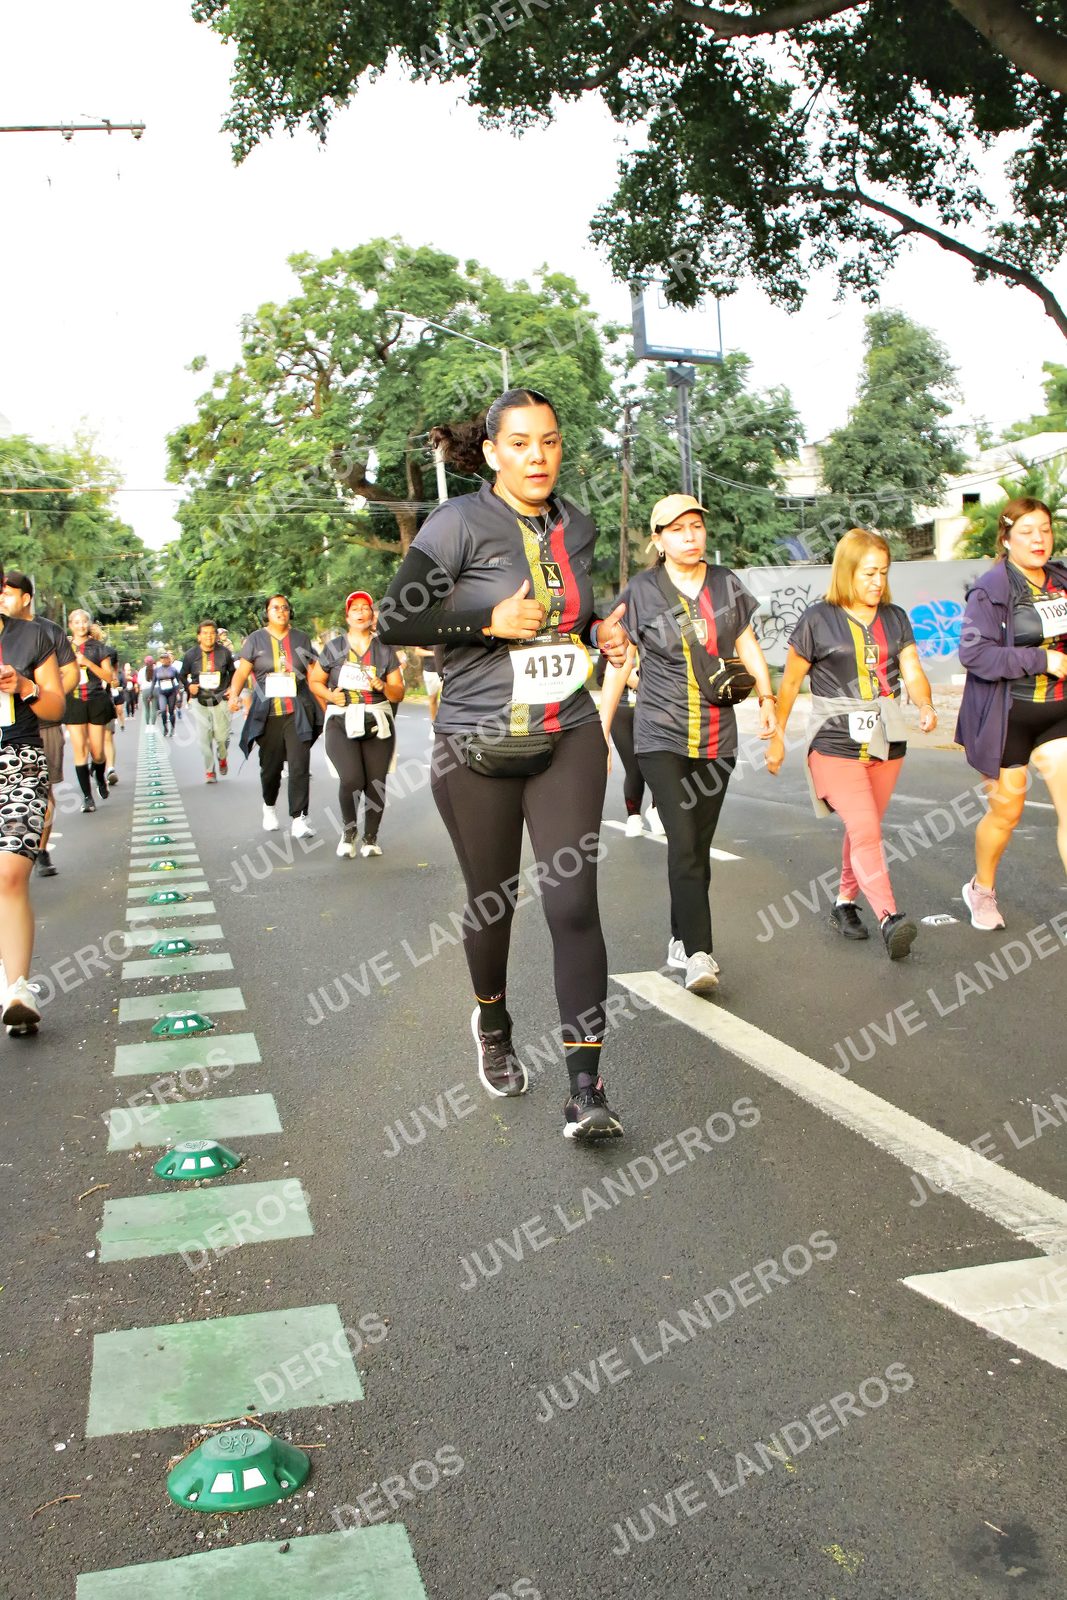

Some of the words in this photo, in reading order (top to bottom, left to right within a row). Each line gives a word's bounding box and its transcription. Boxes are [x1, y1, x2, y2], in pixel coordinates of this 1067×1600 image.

[772, 584, 811, 600] TOY
[525, 653, 576, 679] 4137
[857, 714, 880, 731] 26
